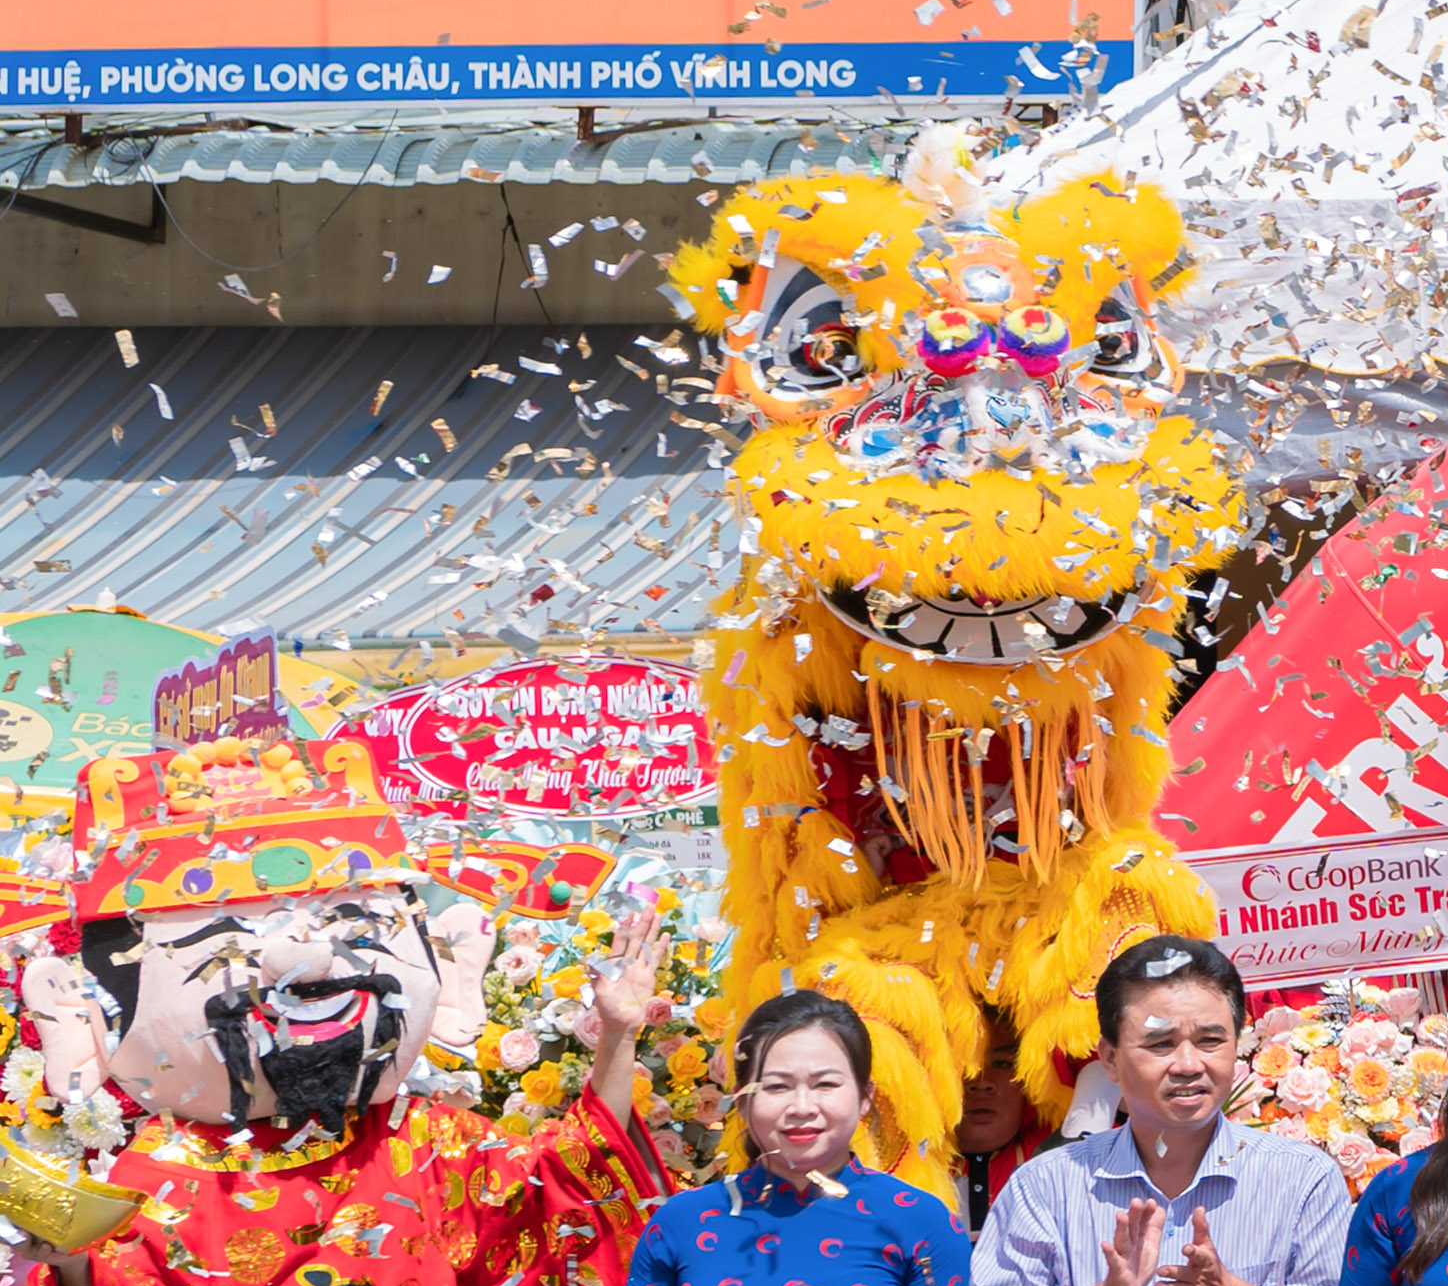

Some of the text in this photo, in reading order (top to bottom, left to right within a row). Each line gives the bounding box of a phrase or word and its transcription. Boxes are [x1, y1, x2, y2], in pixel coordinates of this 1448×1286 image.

[17, 59, 91, 102] HUỆ,
[100, 58, 246, 93] PHƯỜNG
[253, 62, 349, 92] LONG
[356, 55, 460, 95] CHÂU,
[468, 54, 581, 90] THÀNH
[591, 50, 663, 89] PHỐ
[670, 53, 751, 89] VĨNH
[760, 59, 857, 88] LONG
[71, 712, 154, 737] Bác
[1239, 896, 1339, 935] Nhánh
[1349, 890, 1405, 922] Sóc
[1229, 939, 1317, 969] Chúc
